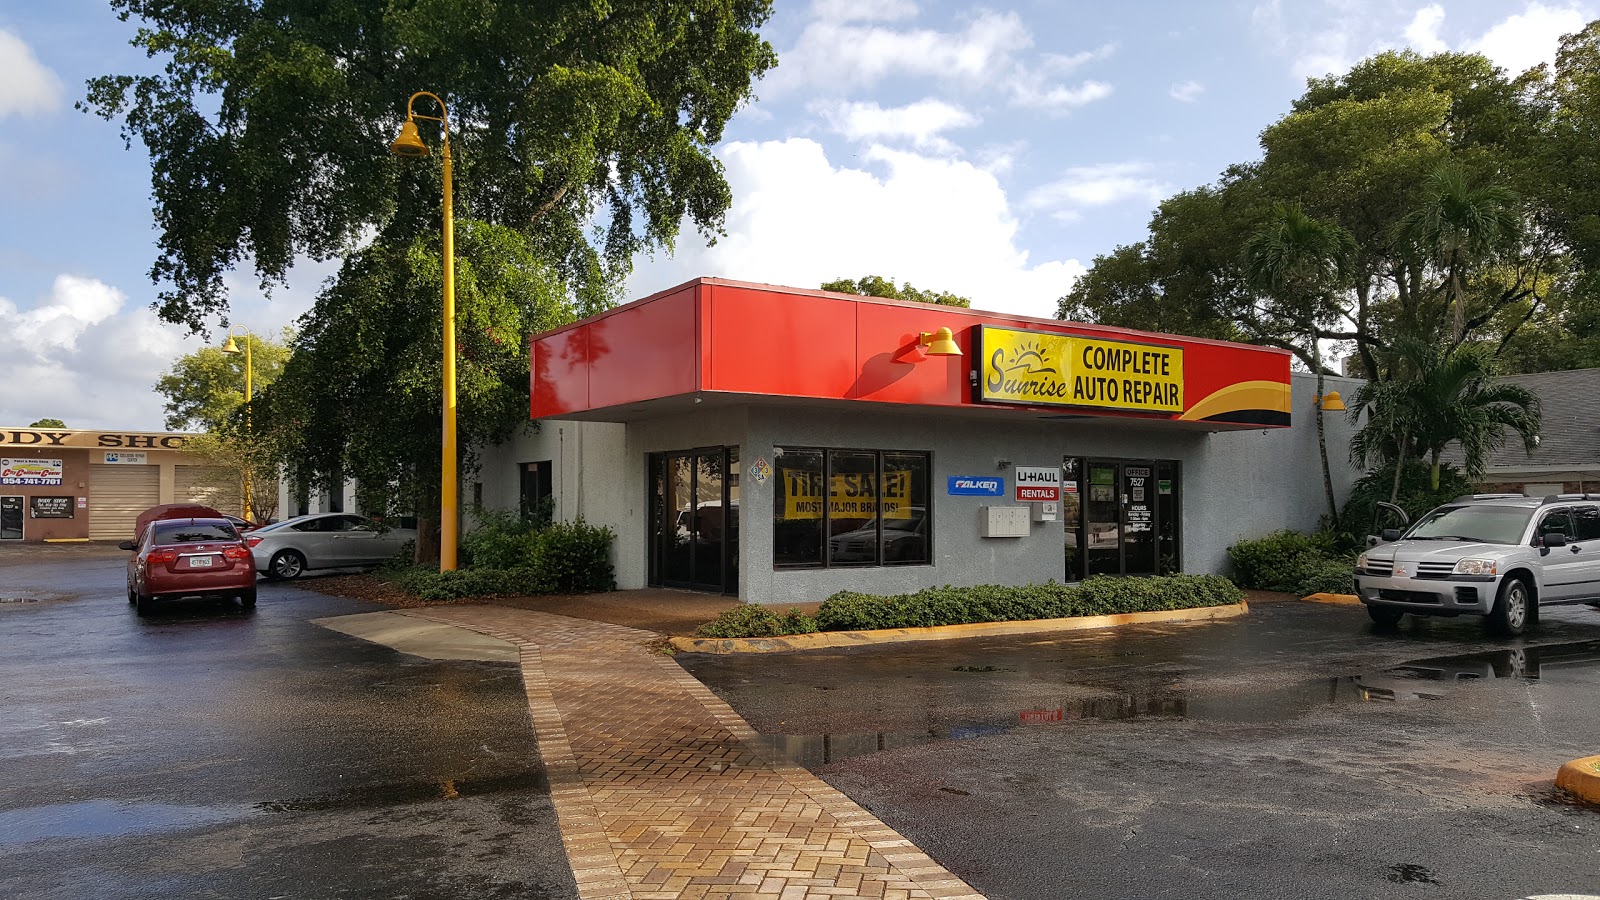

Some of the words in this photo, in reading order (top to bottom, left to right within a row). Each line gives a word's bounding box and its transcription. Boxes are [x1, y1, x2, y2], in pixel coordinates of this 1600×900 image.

[1082, 345, 1170, 376] COMPLETE
[987, 347, 1067, 398] Sunrise
[1073, 375, 1119, 402] AUTO
[1123, 379, 1179, 406] REPAIR
[98, 434, 186, 449] SHO
[1017, 471, 1058, 482] U-HAUL
[1129, 477, 1145, 487] 7527
[787, 471, 838, 497] TIRE
[844, 473, 905, 498] SAE!
[1021, 489, 1055, 498] RENTALS
[795, 501, 822, 513] MOST
[828, 501, 858, 513] MAJOR
